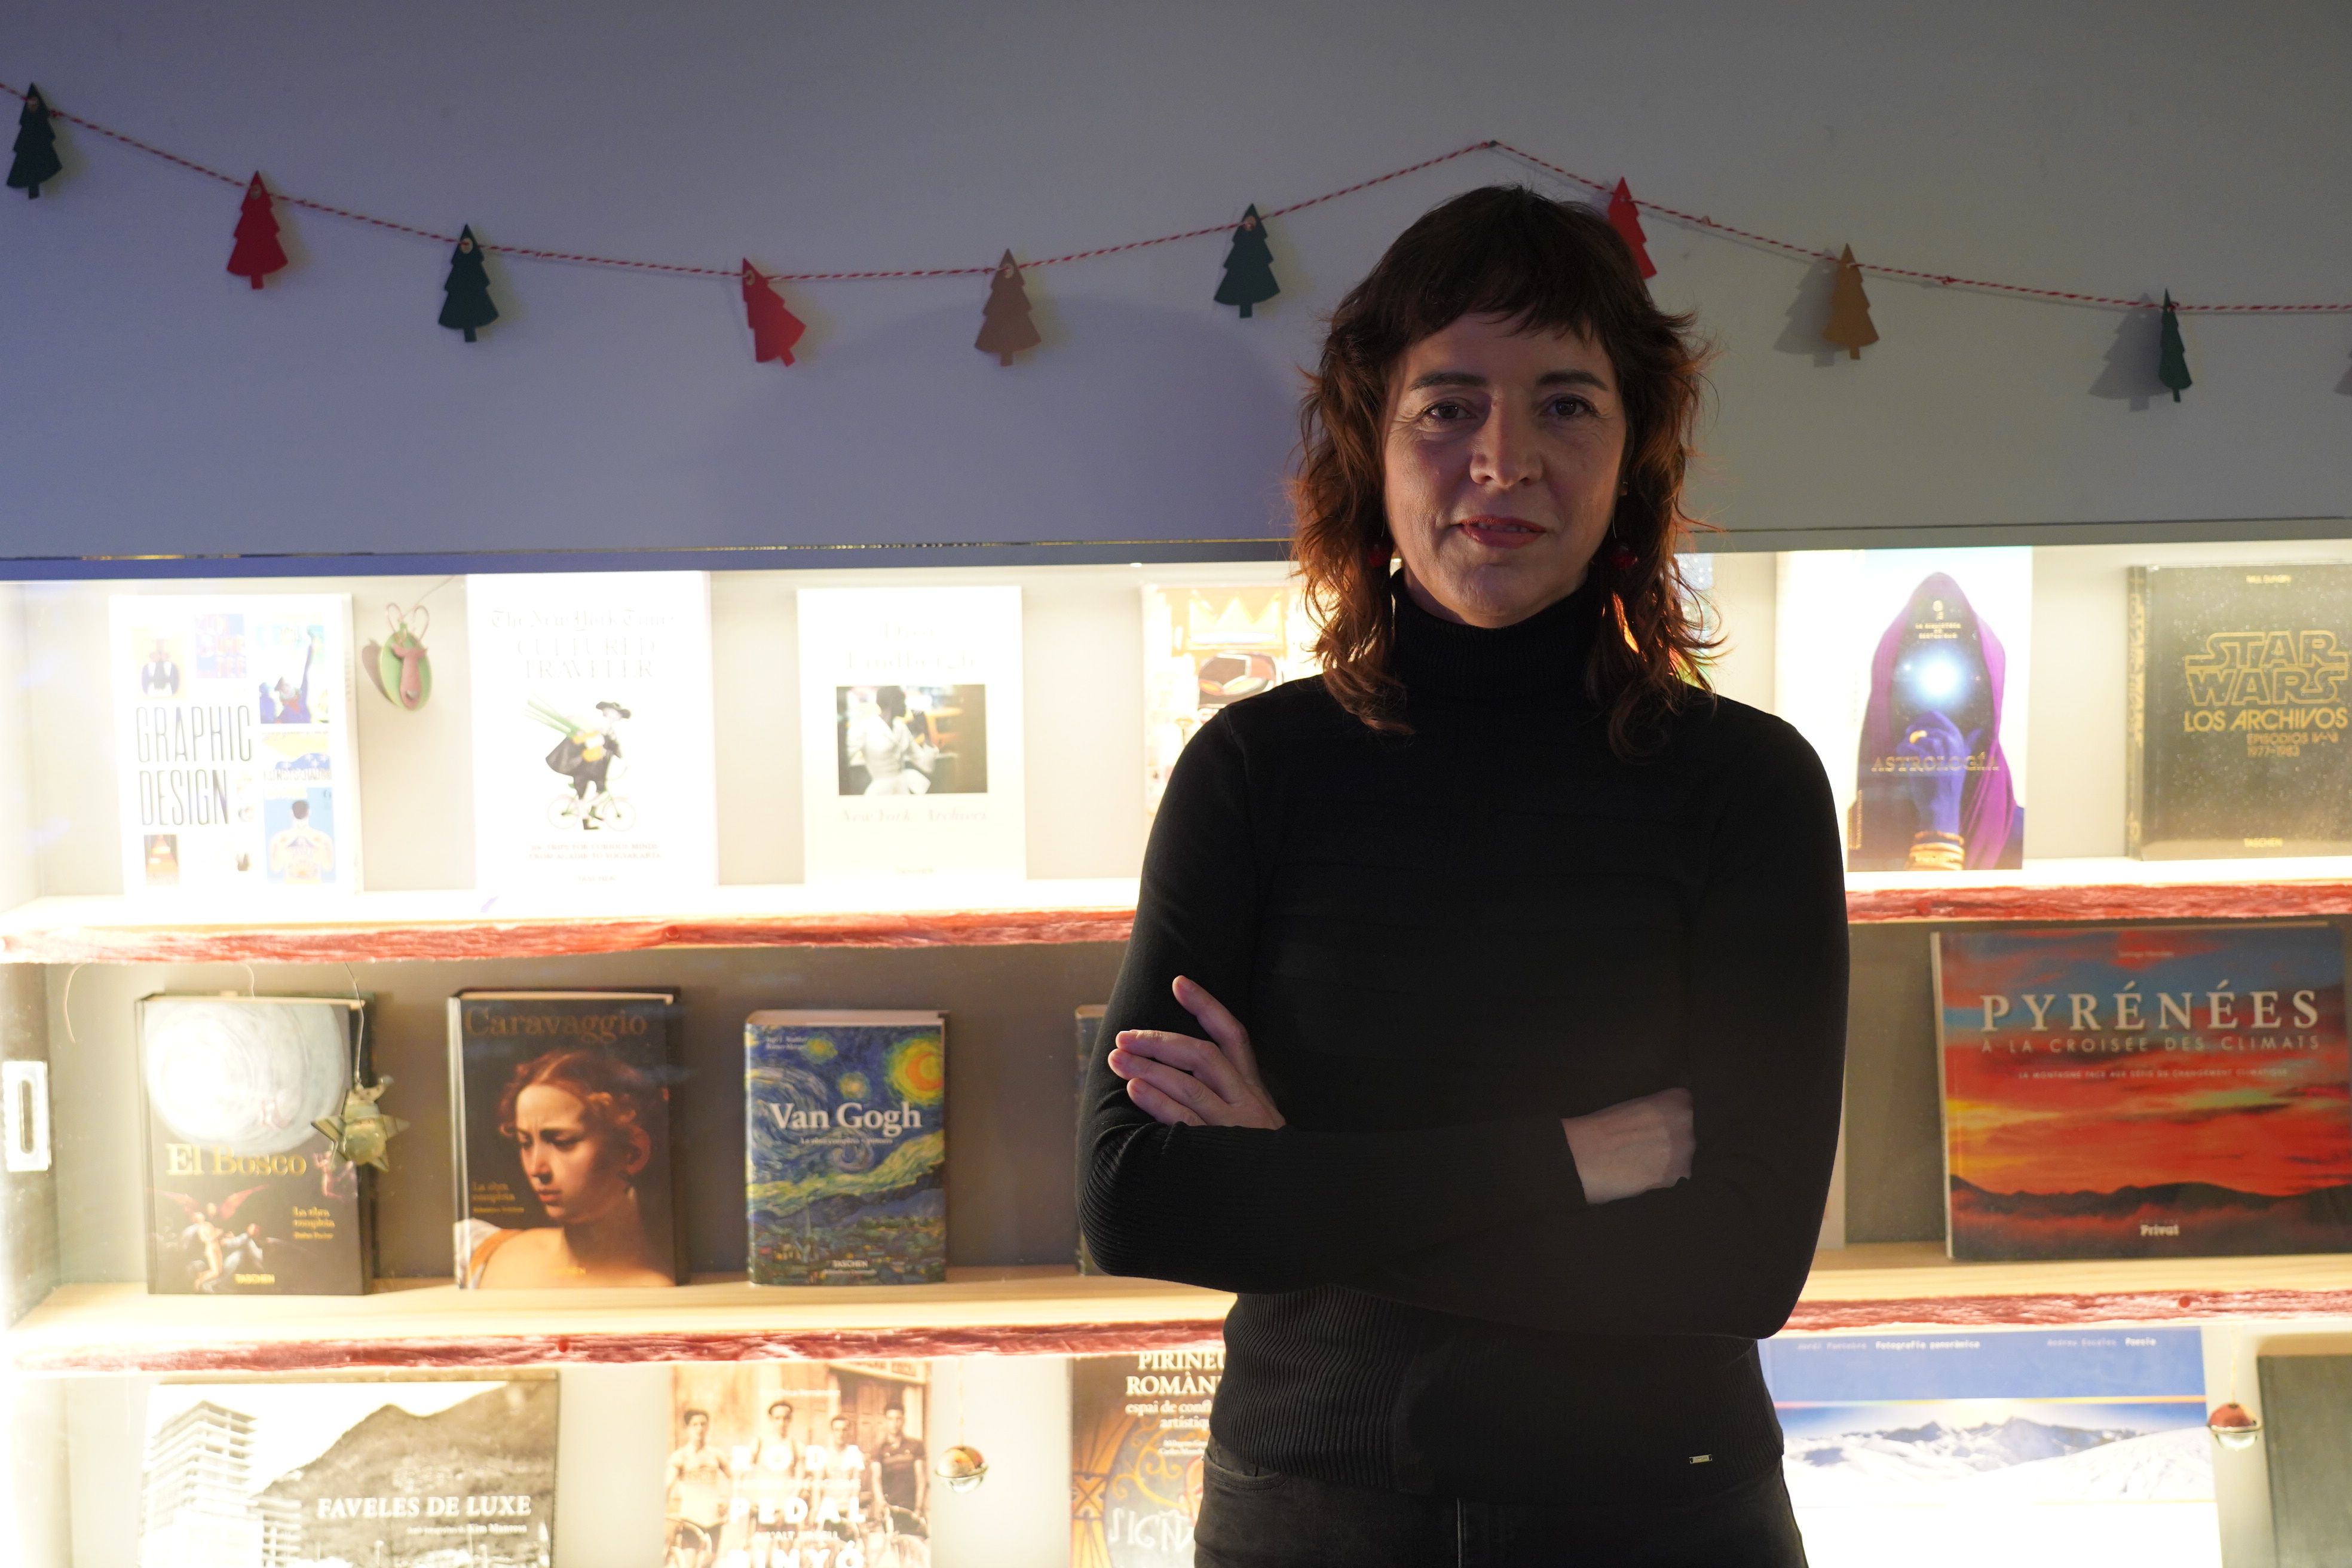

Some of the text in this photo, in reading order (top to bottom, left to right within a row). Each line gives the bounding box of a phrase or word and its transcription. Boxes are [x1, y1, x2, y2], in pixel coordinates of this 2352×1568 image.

[2184, 629, 2349, 669] STAR
[2186, 667, 2349, 706] WARS
[2183, 706, 2348, 732] LOS ARCHIVOS
[136, 705, 252, 762] GRAPHIC
[2246, 732, 2308, 745] EPISODIOS
[1870, 751, 2000, 772] ASTROLOGÍA
[139, 769, 229, 825] DESIGN
[2243, 837, 2283, 849] TASCHEN
[1979, 978, 2320, 1033] PYRÉNÉES
[466, 1006, 647, 1043] Caravaggio
[2008, 1038, 2033, 1053] LA
[2164, 1036, 2206, 1052] DES
[2221, 1034, 2322, 1052] CLIMATS
[2031, 1071, 2082, 1079] MONTAGNE
[2084, 1070, 2106, 1079] FACE
[2172, 1068, 2232, 1078] CHANGEMENT
[768, 1100, 923, 1138] Van Gogh
[165, 1143, 307, 1177] El Bosco
[2140, 1223, 2181, 1237] Privat
[234, 1273, 275, 1285] TASCHEN
[1875, 1340, 1927, 1350] Fotografia
[1125, 1370, 1222, 1396] ROMÀN
[1124, 1399, 1159, 1417] espai
[1160, 1399, 1178, 1414] de
[730, 1444, 866, 1472] RODA
[316, 1494, 531, 1520] FAVELES DE LUXE
[728, 1495, 867, 1525] PEDAL
